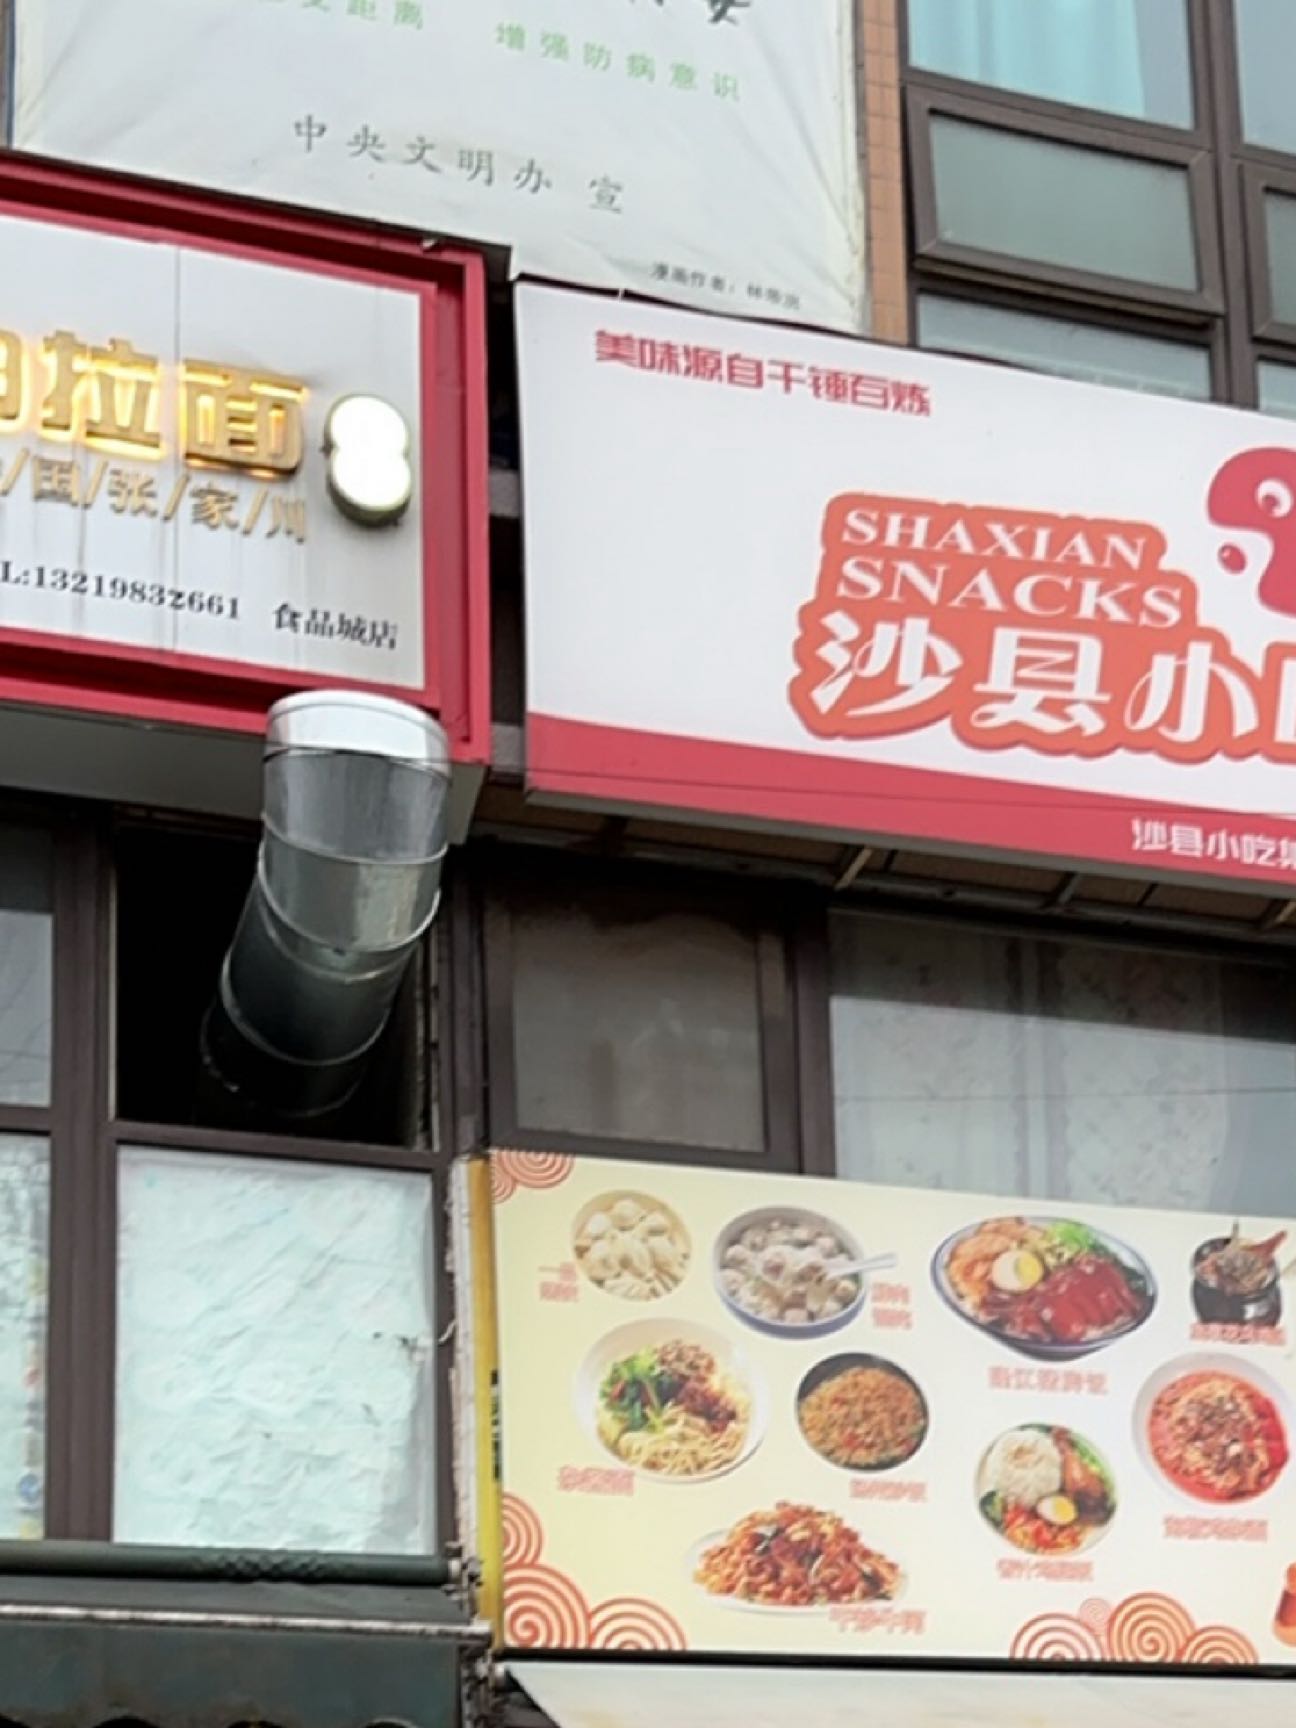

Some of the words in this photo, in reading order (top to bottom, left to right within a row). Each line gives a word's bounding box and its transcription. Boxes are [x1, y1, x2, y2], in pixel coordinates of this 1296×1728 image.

[496, 22, 741, 103] 增强防病意识
[294, 115, 552, 194] 中央文明办
[588, 175, 625, 214] 宣
[595, 329, 931, 416] 美味源自千锤百炼
[842, 509, 1147, 571] SHAXIAN
[273, 603, 397, 649] 食品城店
[836, 558, 1183, 627] SNACKS
